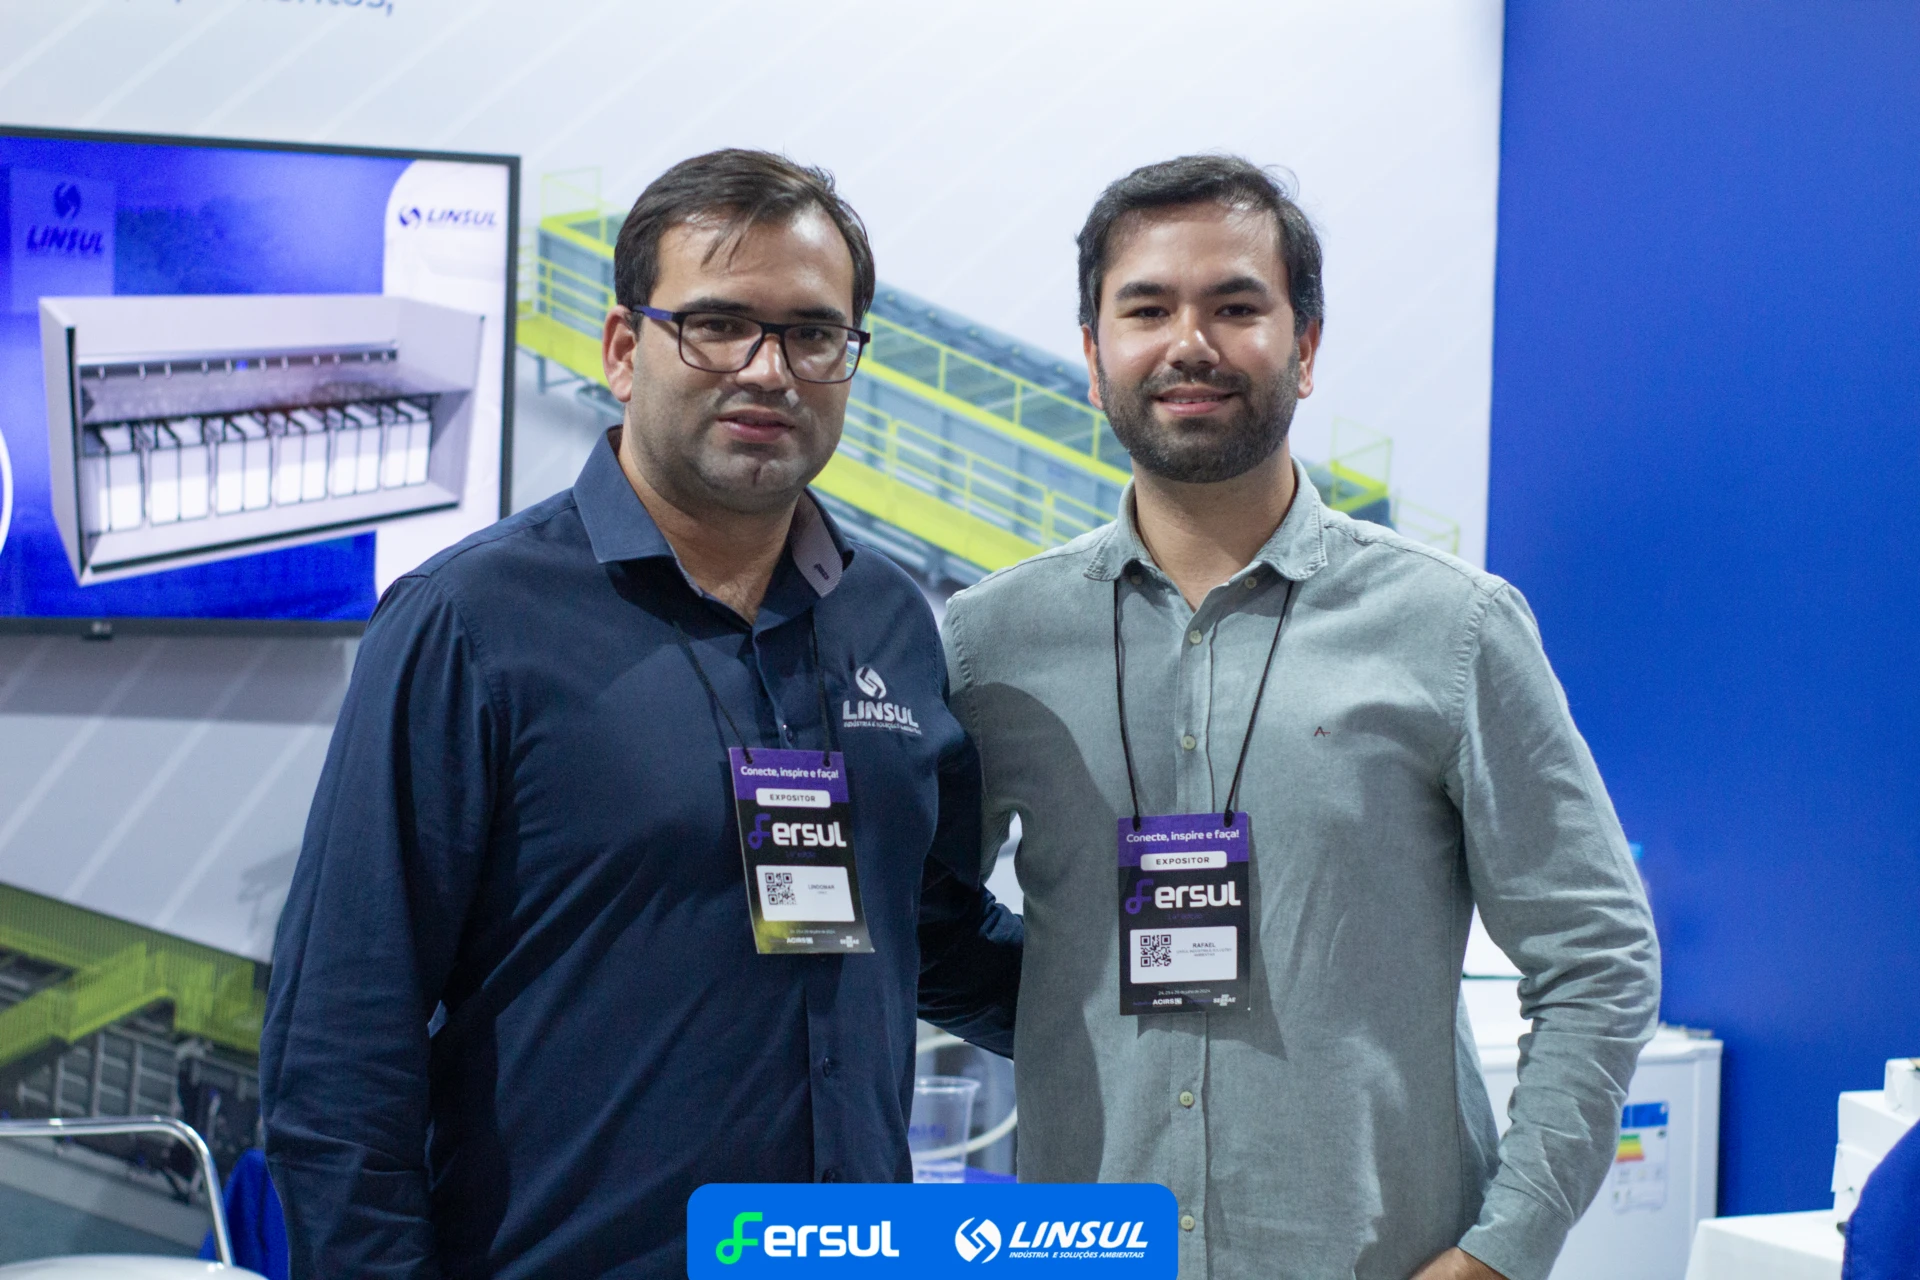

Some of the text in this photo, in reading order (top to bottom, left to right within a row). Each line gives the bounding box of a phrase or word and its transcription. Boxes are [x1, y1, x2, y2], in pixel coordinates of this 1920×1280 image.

[428, 207, 496, 226] LINSUL
[27, 224, 104, 254] LINSUL
[842, 699, 919, 728] LINSUL
[740, 766, 839, 780] Conecte, inspire e faça!
[769, 794, 816, 802] EXPOSITOR
[1126, 829, 1239, 843] Conecte, inspire e faça!
[1155, 856, 1210, 865] EXPOSITOR
